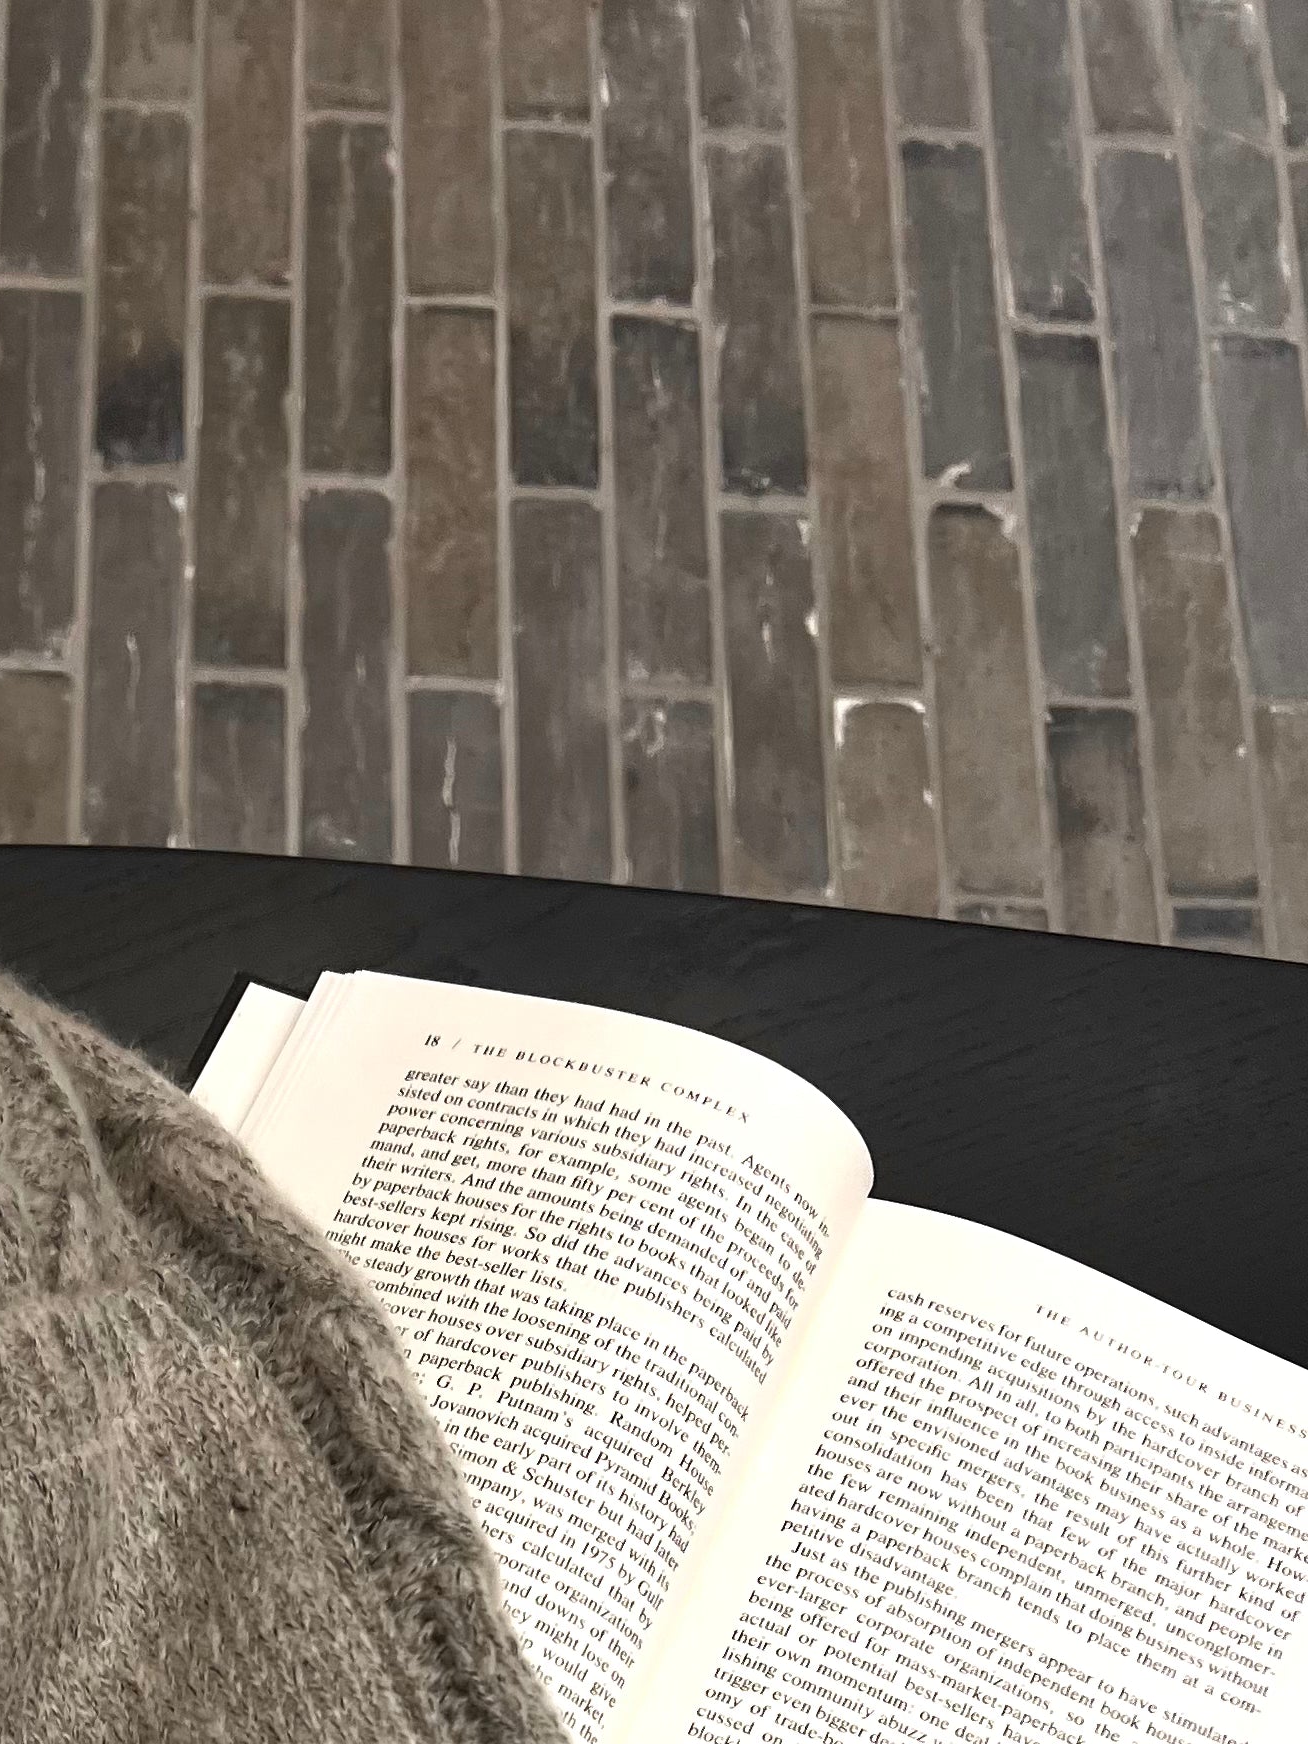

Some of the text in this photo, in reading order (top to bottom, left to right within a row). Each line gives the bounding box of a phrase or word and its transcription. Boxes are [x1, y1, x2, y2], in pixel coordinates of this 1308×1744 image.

[424, 1033, 442, 1048] 18
[473, 1043, 508, 1058] THE
[515, 1050, 651, 1087] BLOCKBUSTER
[660, 1082, 747, 1124] COMPLEX
[386, 1104, 438, 1121] power
[439, 1112, 525, 1138] concerning
[530, 1127, 588, 1150] various
[591, 1142, 677, 1177] subsidiary
[735, 1195, 752, 1215] In
[756, 1209, 778, 1233] the
[780, 1231, 805, 1261] case
[805, 1259, 817, 1276] of
[403, 1069, 461, 1087] greater
[462, 1078, 491, 1094] say
[494, 1080, 529, 1098] than
[533, 1087, 570, 1108] they
[573, 1094, 606, 1113] had
[608, 1102, 642, 1122] had
[643, 1111, 661, 1129] in
[666, 1120, 693, 1139] the
[740, 1154, 791, 1194] Agents
[793, 1192, 819, 1220] now
[322, 1228, 368, 1247] might
[369, 1239, 412, 1256] make
[415, 1244, 441, 1261] the
[444, 1249, 528, 1280] best-seller
[342, 1189, 427, 1218] best-sellers
[429, 1205, 467, 1227] kept
[523, 1225, 547, 1243] So
[551, 1233, 580, 1252] did
[582, 1242, 610, 1261] the
[613, 1255, 689, 1295] advances
[692, 1287, 733, 1325] being
[732, 1320, 763, 1350] paid
[761, 1343, 775, 1367] by
[420, 1148, 452, 1162] and
[485, 1159, 528, 1177] more
[531, 1166, 567, 1186] than
[569, 1175, 605, 1197] fifty
[605, 1188, 637, 1205] per
[639, 1199, 675, 1220] cent
[678, 1215, 701, 1229] of
[699, 1223, 725, 1244] the
[725, 1241, 785, 1293] proceeds
[784, 1287, 799, 1311] for
[429, 1394, 519, 1431] Jovanovich
[521, 1424, 594, 1460] acquired
[593, 1450, 659, 1497] Pyramid
[887, 1289, 925, 1307] cash
[927, 1300, 996, 1332] reserves
[997, 1324, 1023, 1343] for
[1023, 1335, 1072, 1366] future
[1163, 1404, 1199, 1429] such
[1201, 1422, 1289, 1469] advantages
[1290, 1464, 1308, 1478] as
[583, 1425, 654, 1469] acquired
[660, 1465, 706, 1516] Berkley
[780, 1519, 845, 1548] petitive
[823, 1429, 1292, 1641] consolidation has been that few of the major hardcover
[847, 1375, 880, 1393] and
[883, 1385, 923, 1408] their
[926, 1402, 1000, 1440] influence
[1003, 1436, 1020, 1450] in
[1024, 1444, 1050, 1464] the
[1054, 1456, 1094, 1486] book
[1099, 1477, 1165, 1520] business
[1169, 1515, 1187, 1530] as
[1191, 1526, 1202, 1537] a
[1266, 1556, 1308, 1586] How
[484, 1502, 665, 1612] acquired in 1975 by Gulf
[534, 1593, 635, 1669] downs of their
[721, 1645, 778, 1680] lishing
[782, 1672, 875, 1720] community
[877, 1714, 928, 1744] abuzz
[756, 1575, 849, 1615] ever-larger
[856, 1613, 935, 1655] corporate
[1066, 1711, 1085, 1726] so
[1094, 1722, 1121, 1743] the
